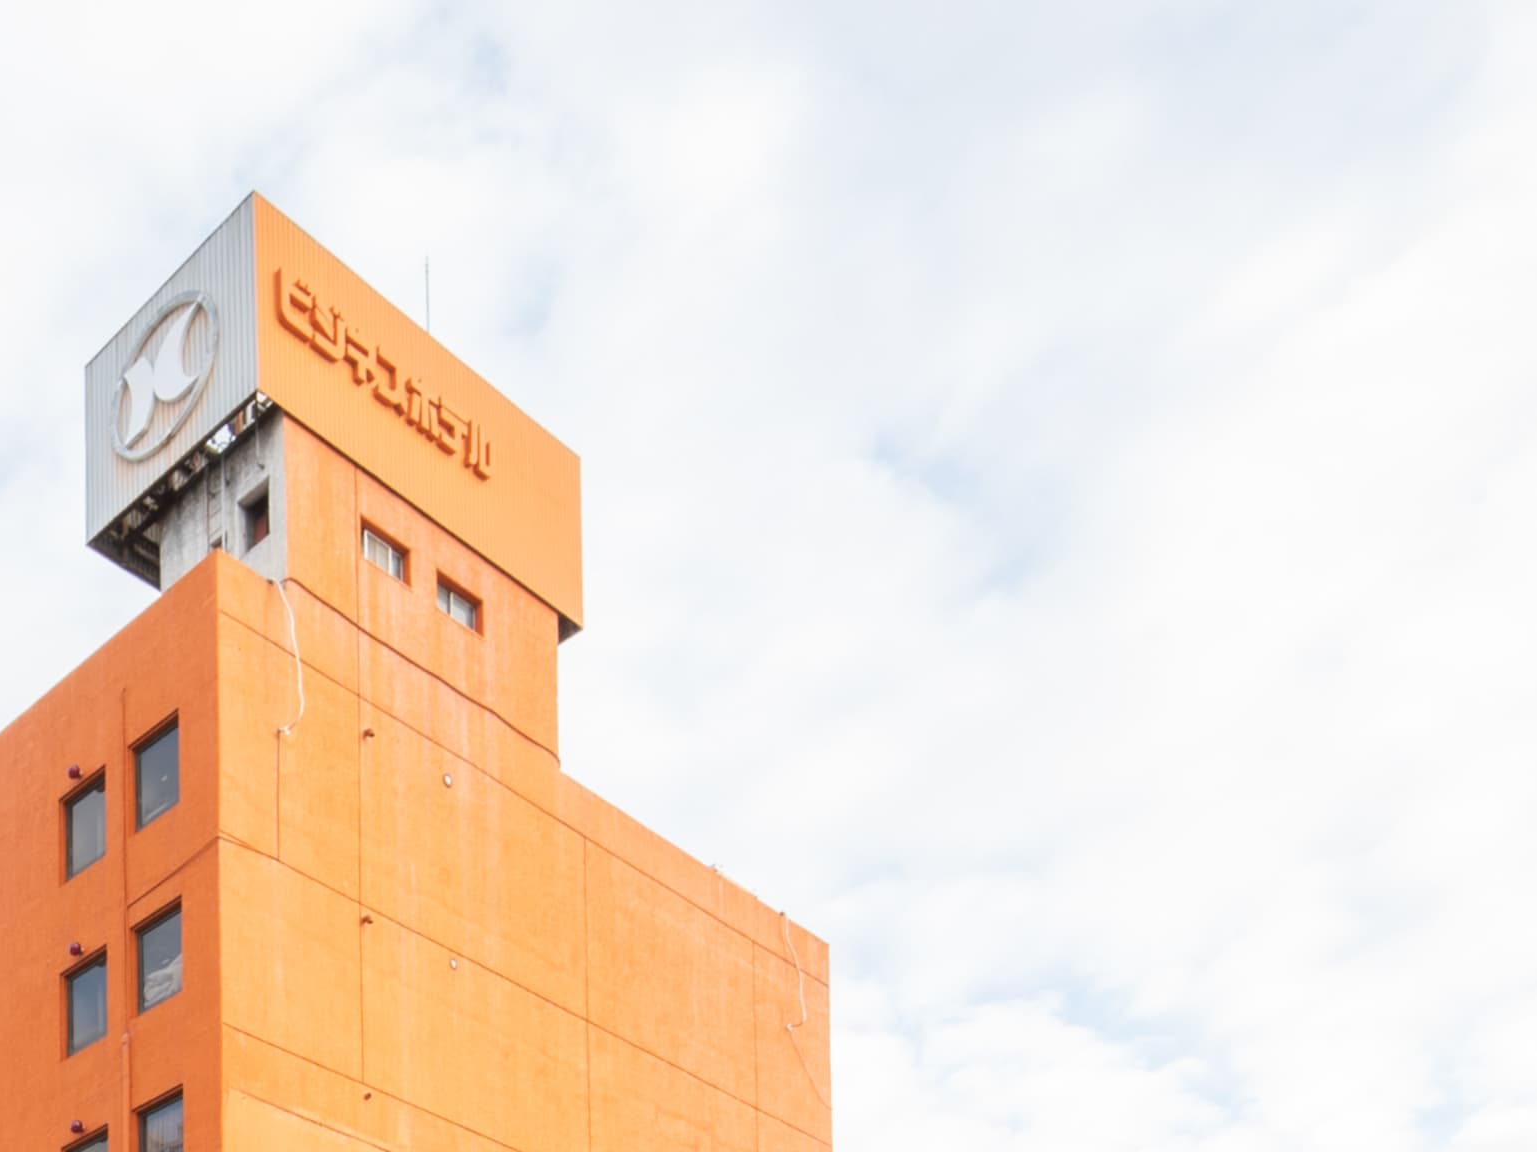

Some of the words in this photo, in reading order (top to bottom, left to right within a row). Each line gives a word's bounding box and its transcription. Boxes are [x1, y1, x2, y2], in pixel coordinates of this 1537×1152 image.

[273, 267, 491, 481] ビジネスホテル
